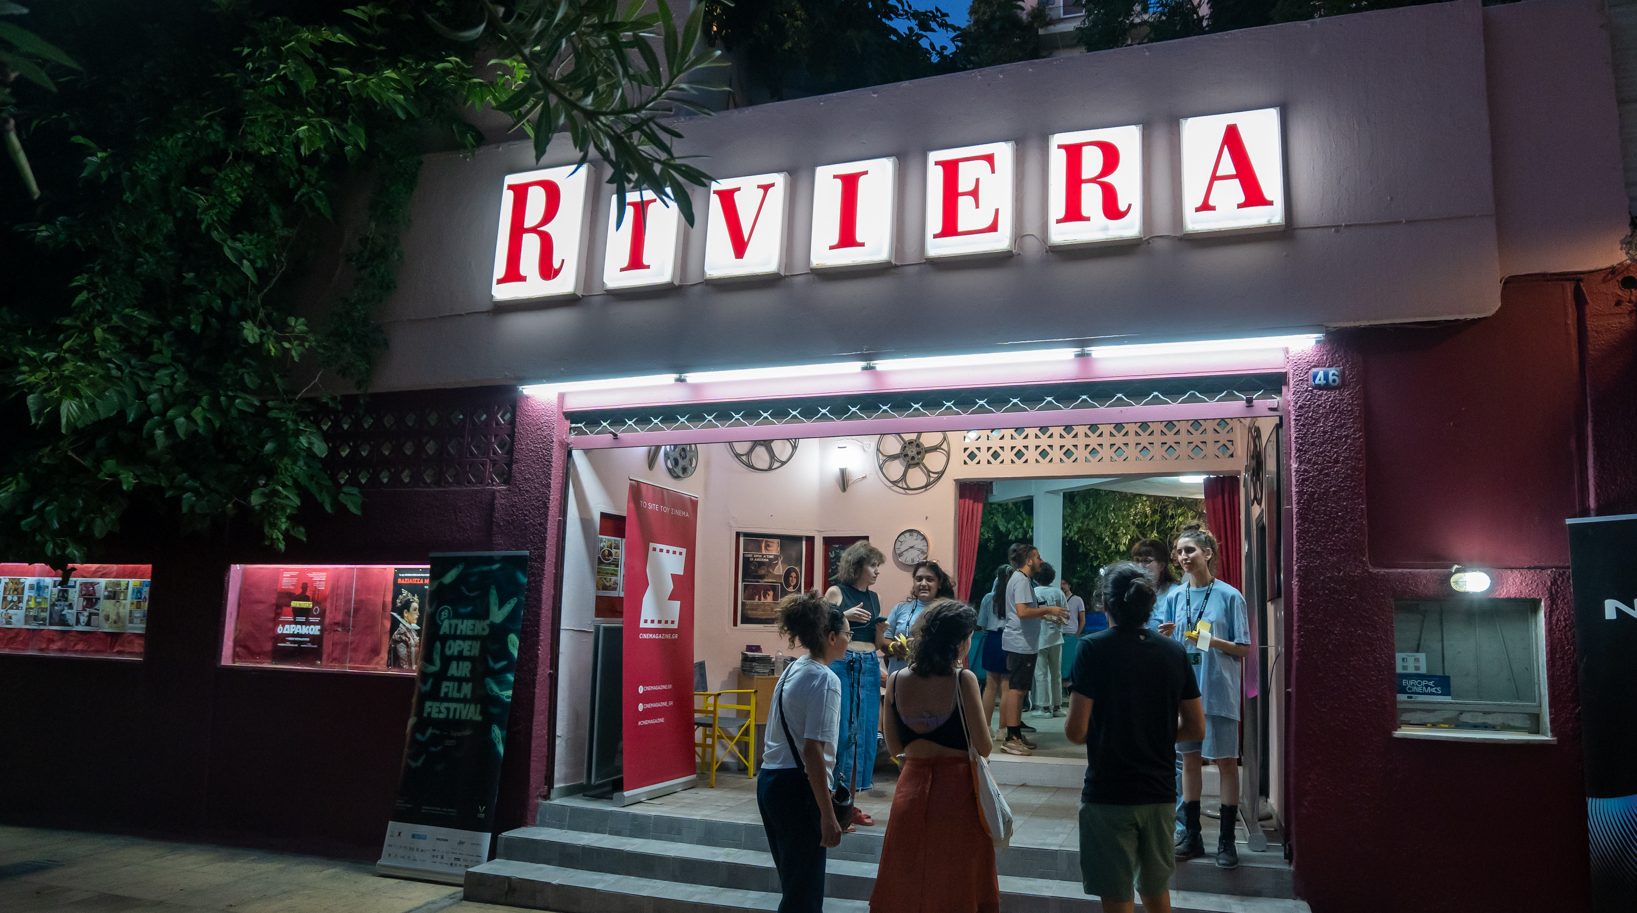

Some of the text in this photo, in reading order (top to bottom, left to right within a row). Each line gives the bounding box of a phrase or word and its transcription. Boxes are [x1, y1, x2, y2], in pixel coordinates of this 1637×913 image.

[496, 123, 1274, 286] RIVIERA
[1315, 370, 1339, 387] 46
[648, 503, 658, 511] SITE
[440, 619, 490, 635] ATHENS
[445, 640, 481, 656] OPEN
[447, 661, 472, 678] AIR
[440, 681, 473, 698] FILM
[1402, 679, 1435, 687] EUROPA
[1406, 686, 1441, 694] CINEMAS
[423, 701, 483, 720] FESTIVAL
